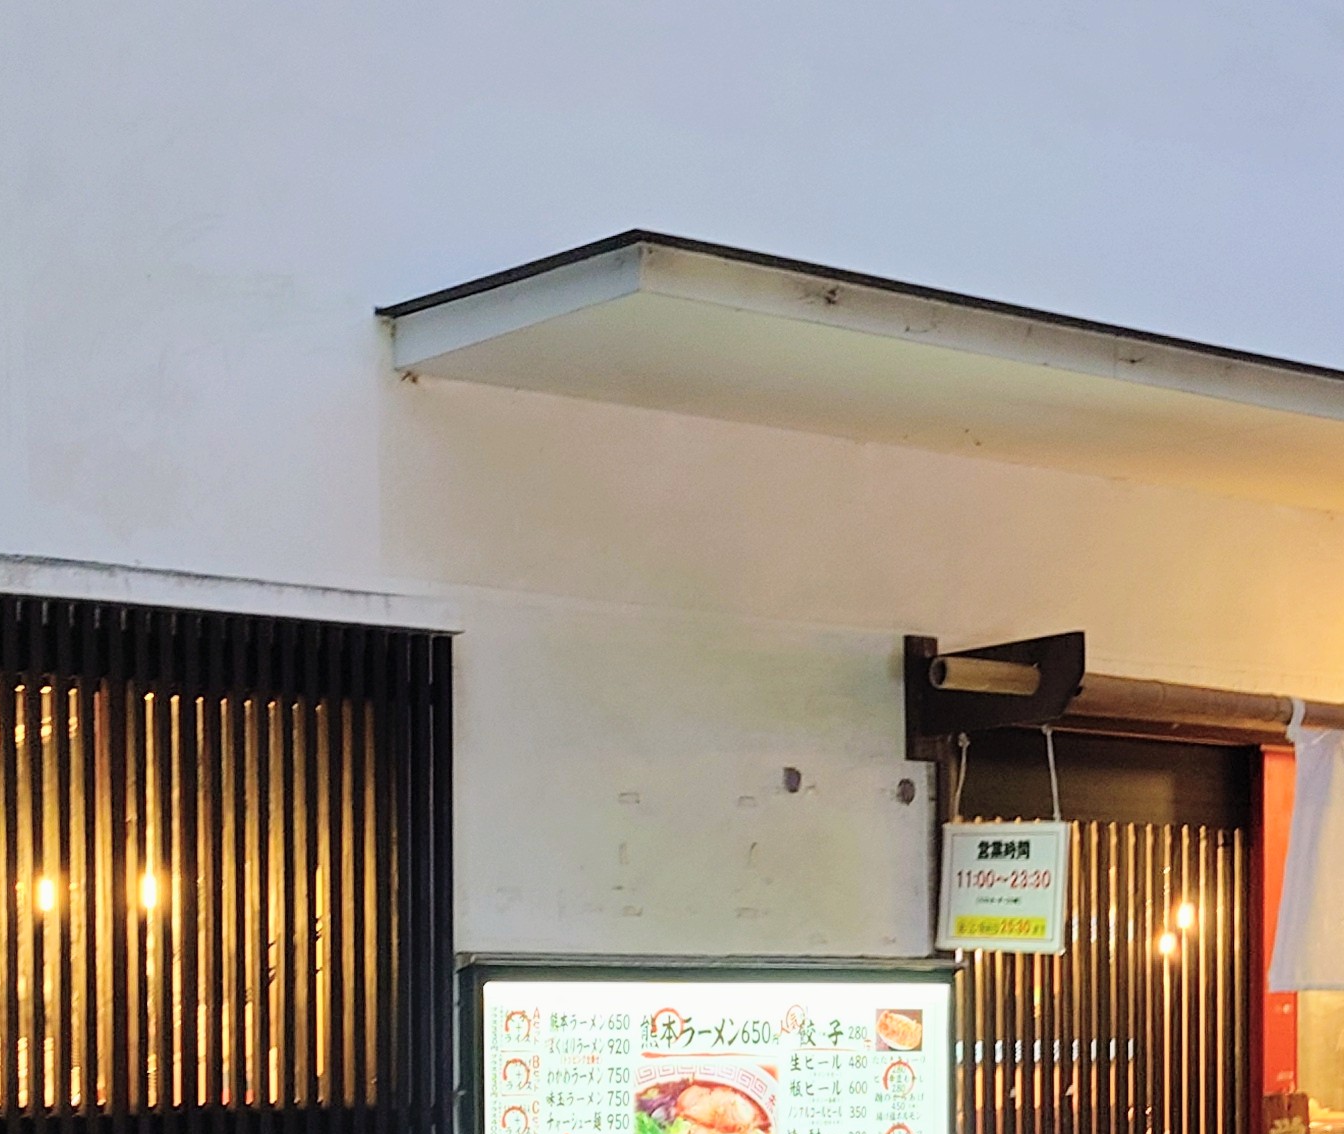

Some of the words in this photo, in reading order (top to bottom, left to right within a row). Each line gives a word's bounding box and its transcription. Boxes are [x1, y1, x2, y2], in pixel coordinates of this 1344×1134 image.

[977, 839, 1032, 860] 営業時間
[607, 1013, 631, 1031] 650
[847, 1025, 868, 1041] 280
[607, 1038, 631, 1055] 920
[790, 1053, 843, 1072] 生ビール
[848, 1054, 868, 1070] 480
[607, 1067, 630, 1084] 750
[789, 1080, 843, 1097] 瓶ビール
[848, 1080, 868, 1095] 600
[607, 1090, 630, 1107] 750
[849, 1105, 867, 1119] 350
[606, 1113, 630, 1130] 950
